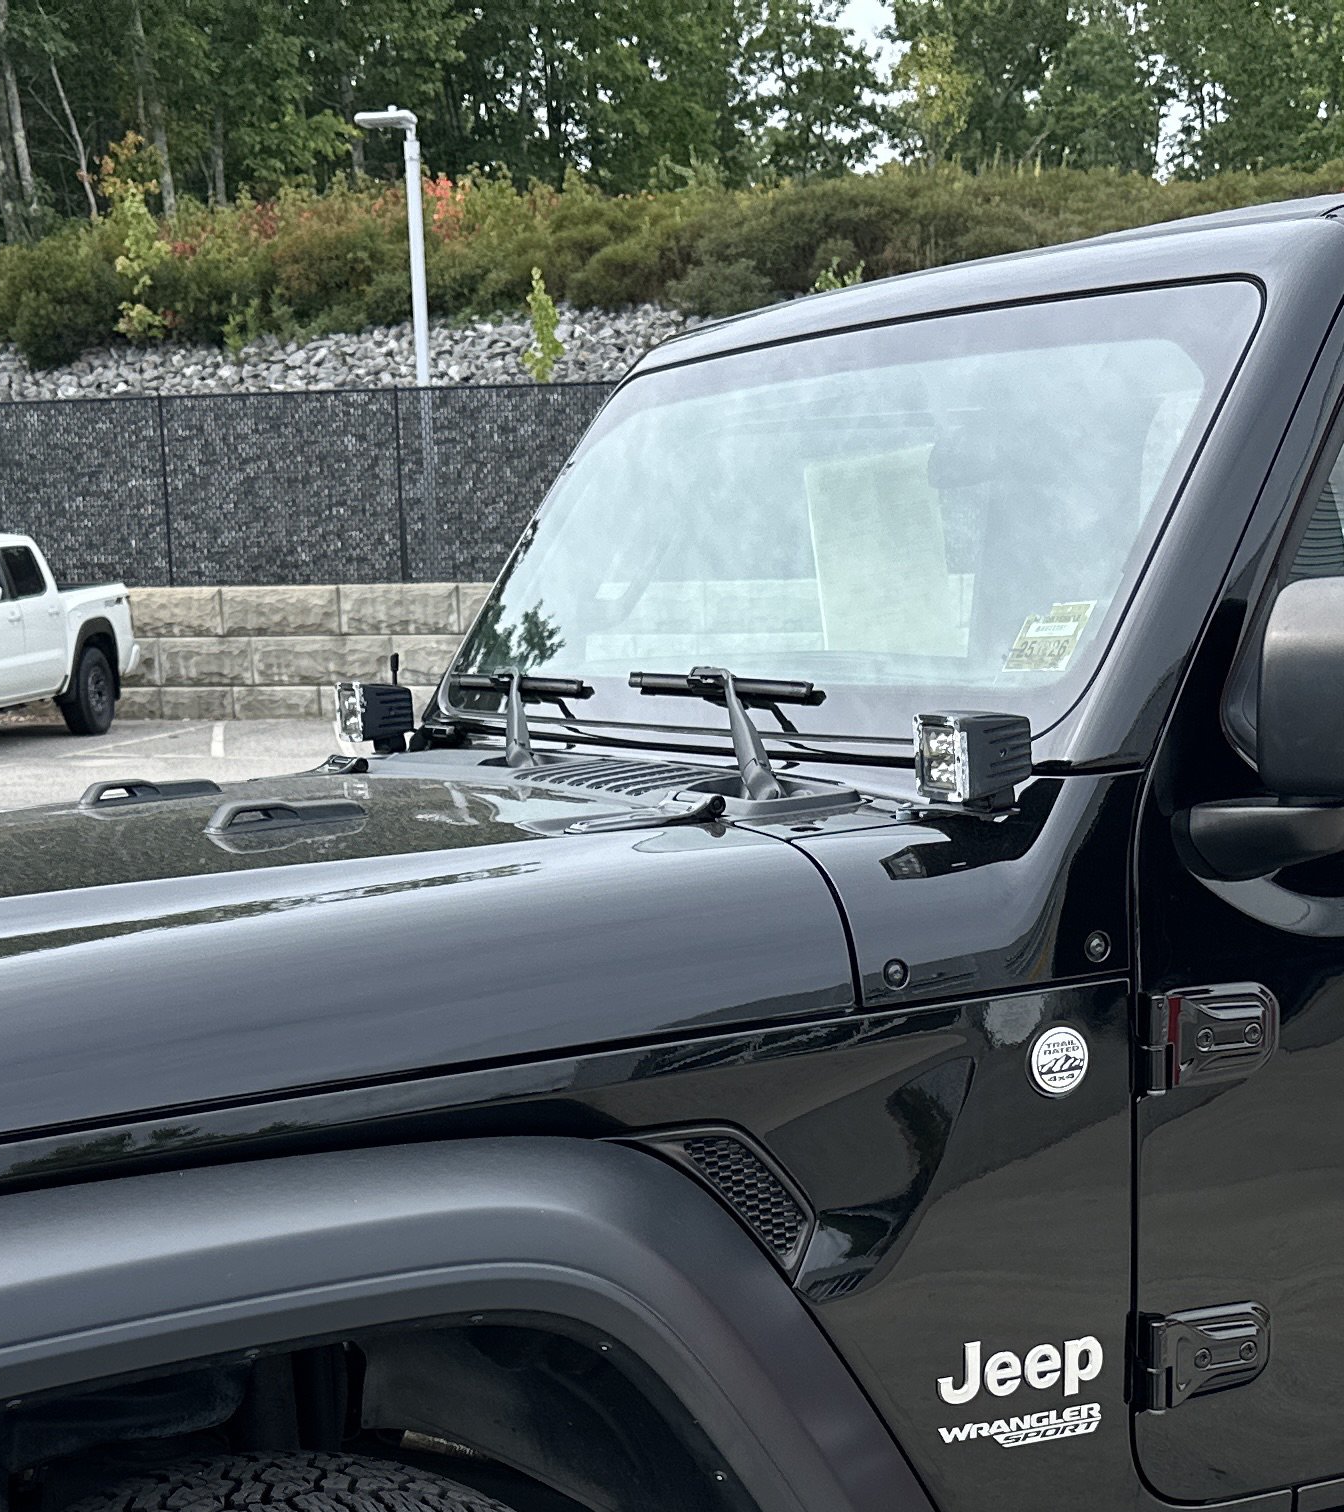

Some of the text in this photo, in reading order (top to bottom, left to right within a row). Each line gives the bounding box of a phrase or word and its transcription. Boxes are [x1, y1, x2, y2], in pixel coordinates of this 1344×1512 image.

[1043, 1046, 1080, 1056] RATED
[1044, 1040, 1077, 1049] TRAIL
[937, 1335, 1104, 1405] Jeep
[937, 1402, 1102, 1444] WRANGLER
[1002, 1420, 1097, 1444] SPORT
